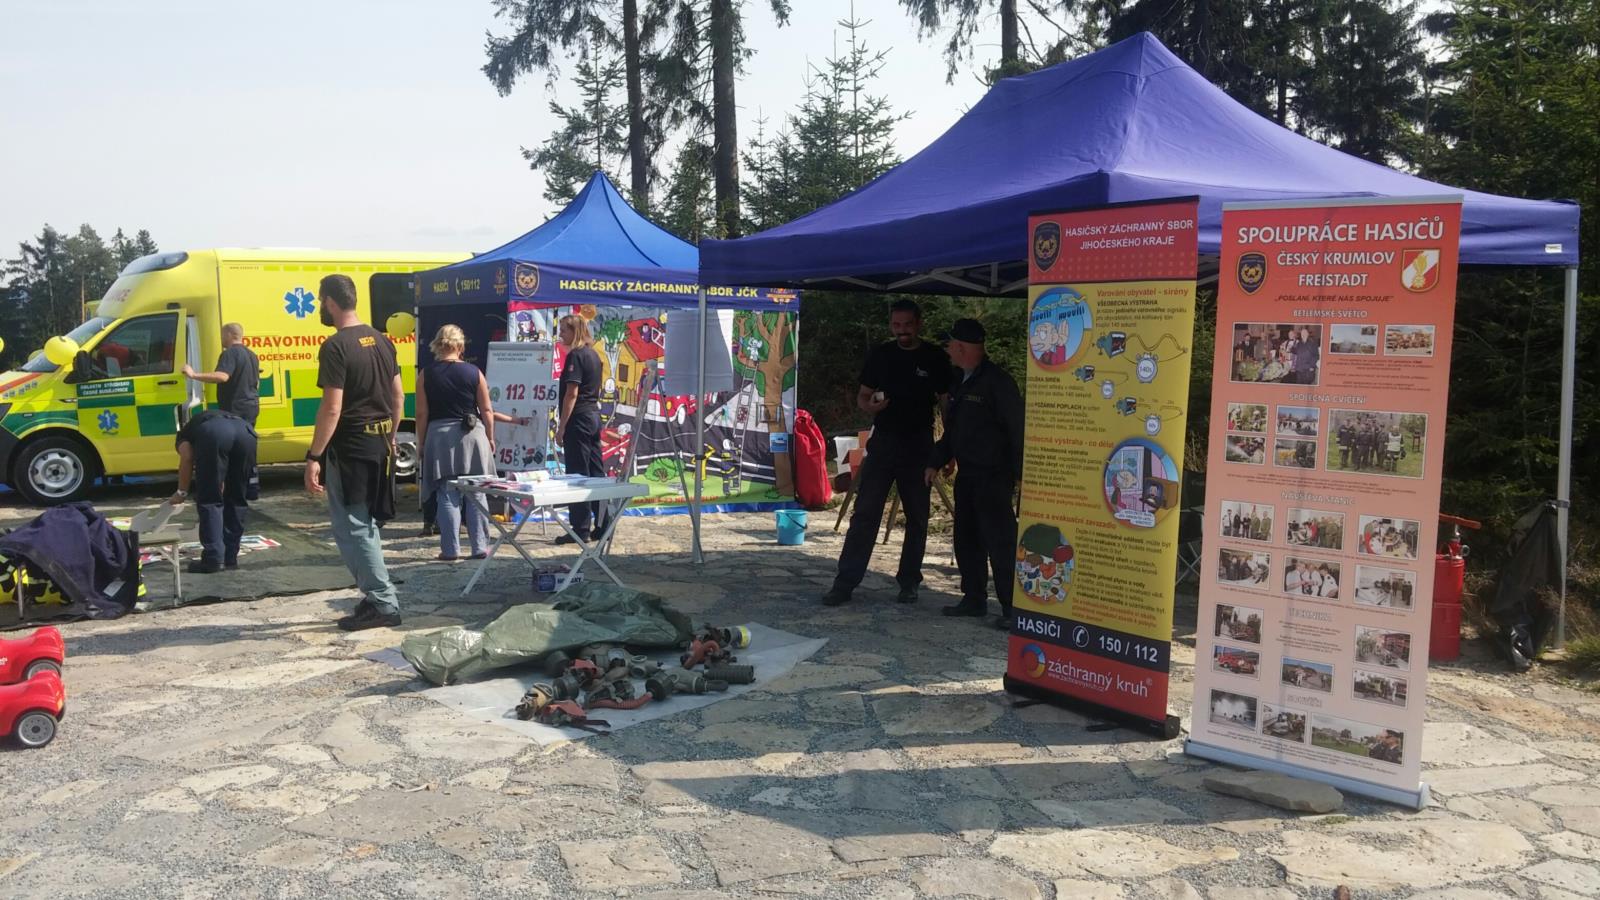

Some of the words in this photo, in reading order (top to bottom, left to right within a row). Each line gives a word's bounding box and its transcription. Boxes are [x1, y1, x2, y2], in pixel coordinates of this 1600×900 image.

[1065, 225, 1108, 237] HASIČSKÝ
[1109, 219, 1165, 234] ZÁCHRANNÝ
[1167, 219, 1194, 230] SBOR
[1237, 221, 1358, 244] SPOLUPRÁCE
[1364, 216, 1444, 241] HASIČŮ
[1080, 236, 1141, 250] JIHOČESKÉHO
[1143, 235, 1175, 246] KRAJE
[1276, 249, 1320, 266] ČESKÝ
[1323, 251, 1395, 266] KRUMLOV
[559, 279, 623, 292] HASIČSKÝ
[626, 280, 700, 295] ZÁCHRANNÝ
[706, 286, 734, 297] BOR
[736, 287, 758, 298] JČK
[1298, 273, 1369, 287] FREISTADT
[506, 383, 526, 401] 112
[1017, 615, 1061, 639] HASIČI
[1099, 635, 1122, 653] 150
[1125, 641, 1131, 656] /
[1134, 644, 1158, 663] 112
[1048, 658, 1113, 691] záchranný
